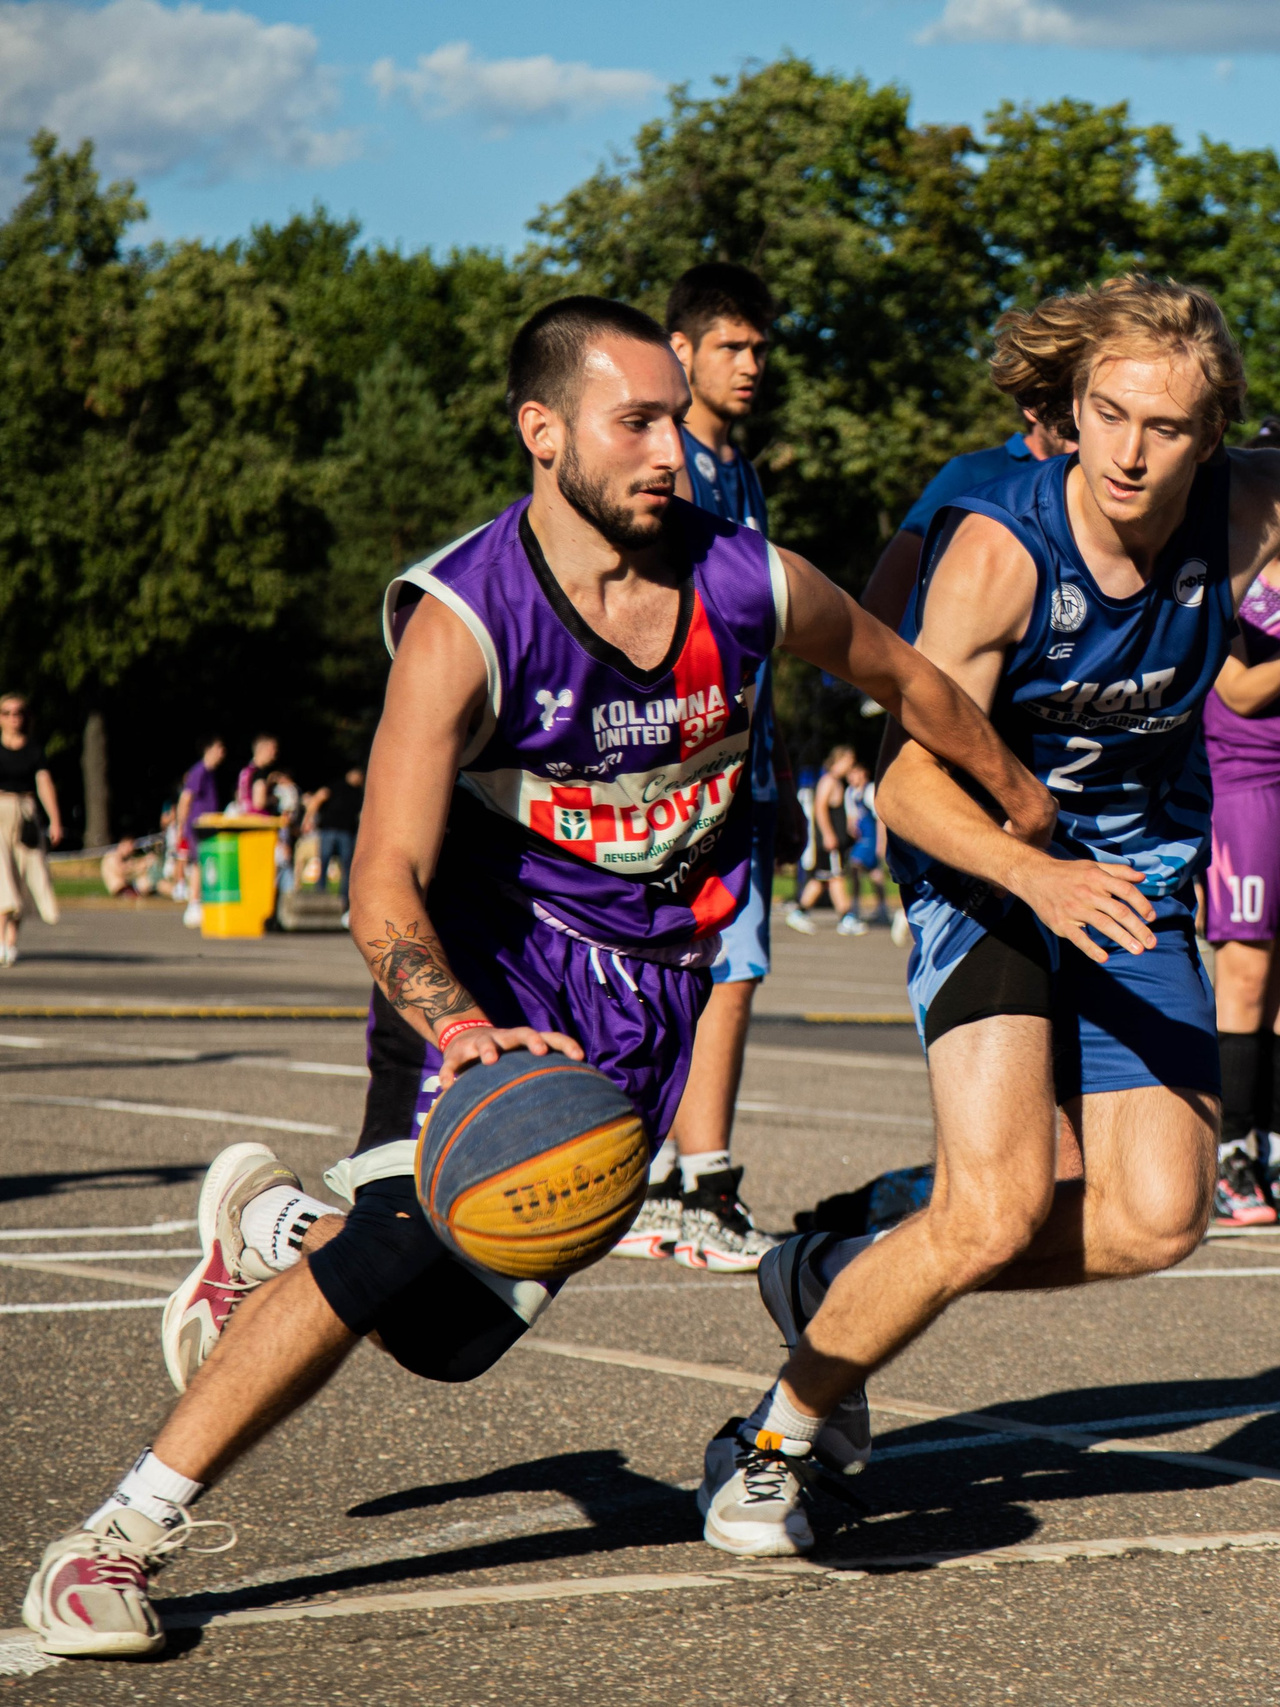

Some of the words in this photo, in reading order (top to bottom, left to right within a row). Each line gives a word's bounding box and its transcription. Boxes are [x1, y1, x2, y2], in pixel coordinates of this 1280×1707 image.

[592, 684, 726, 732] KOLOMNA
[684, 709, 726, 749] 35
[594, 725, 671, 752] UNITED
[1046, 736, 1103, 792] 2
[1227, 875, 1265, 923] 10
